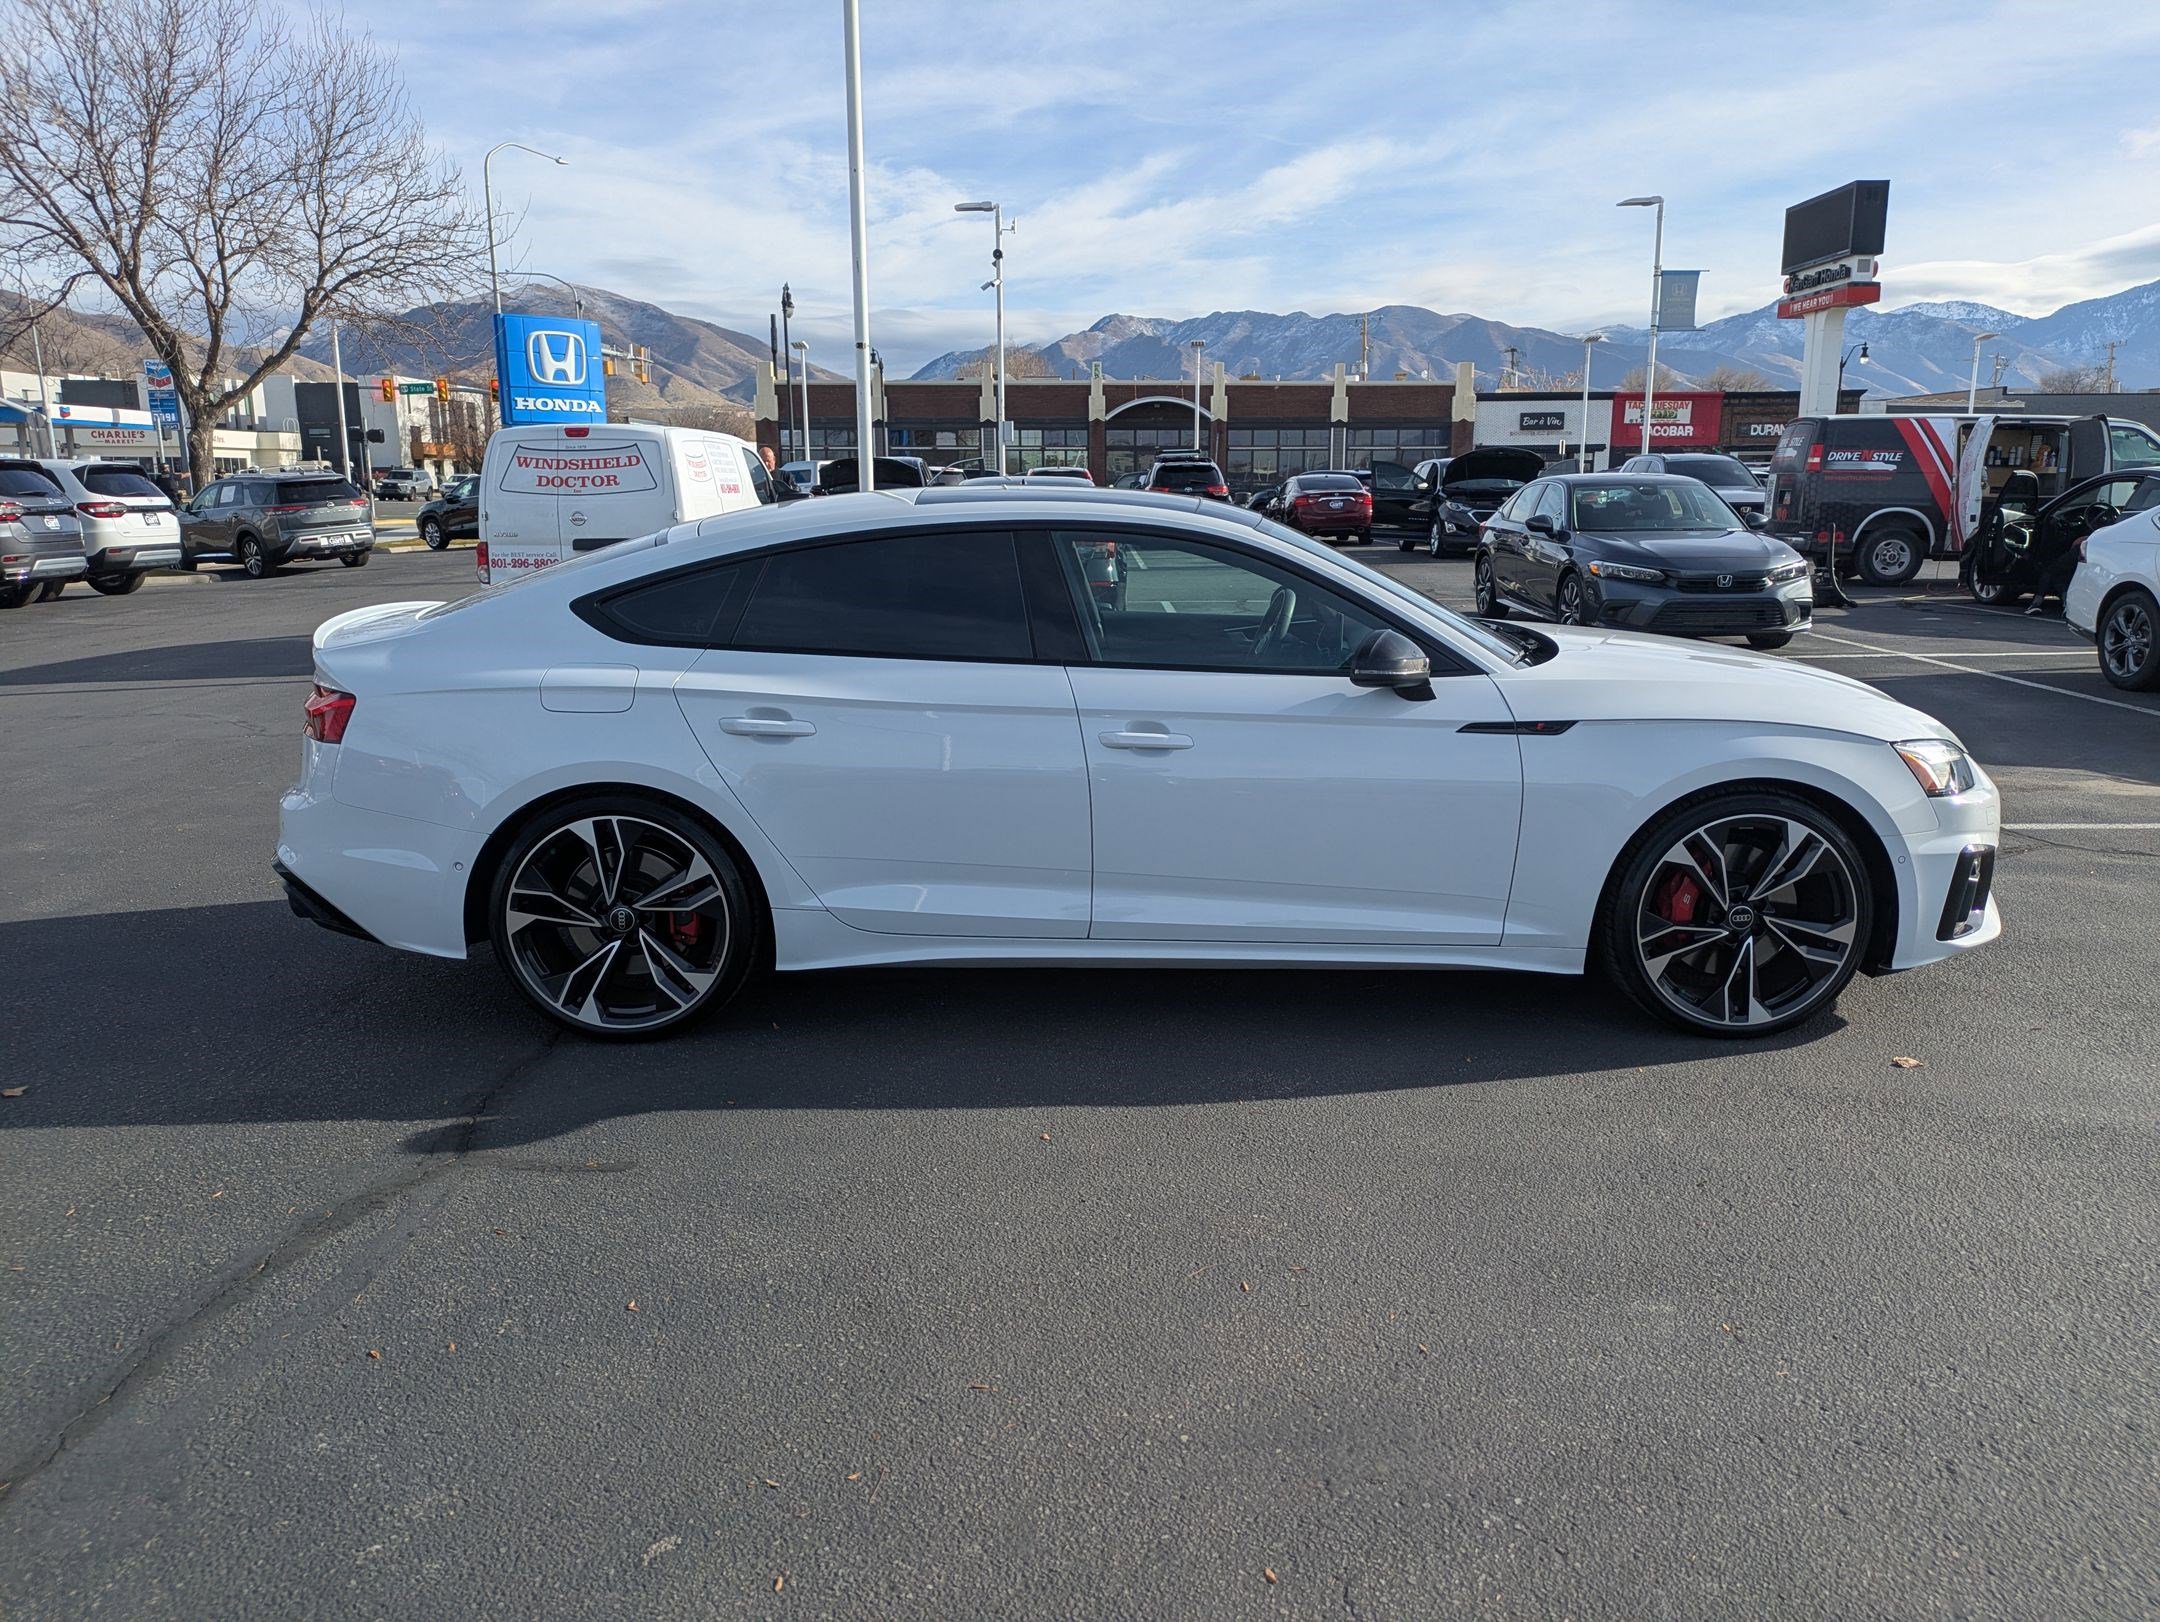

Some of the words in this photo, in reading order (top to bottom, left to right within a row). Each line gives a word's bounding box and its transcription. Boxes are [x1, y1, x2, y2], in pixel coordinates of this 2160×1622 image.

[1819, 266, 1846, 283] Honda
[1794, 302, 1801, 311] WE
[1802, 297, 1817, 309] HEAR
[1818, 295, 1831, 306] YOU
[515, 397, 603, 413] HONDA
[1628, 401, 1645, 410] TAC
[1651, 400, 1690, 410] TUESDAY
[1523, 416, 1539, 426] Bar
[1547, 416, 1562, 426] Vin
[91, 430, 145, 439] CHARLIE'S
[1827, 451, 1861, 461] DRIVE
[1861, 449, 1873, 461] N
[1872, 452, 1904, 461] STYLE
[516, 455, 641, 470] WINDSHIELD
[536, 474, 620, 488] DOCTOR
